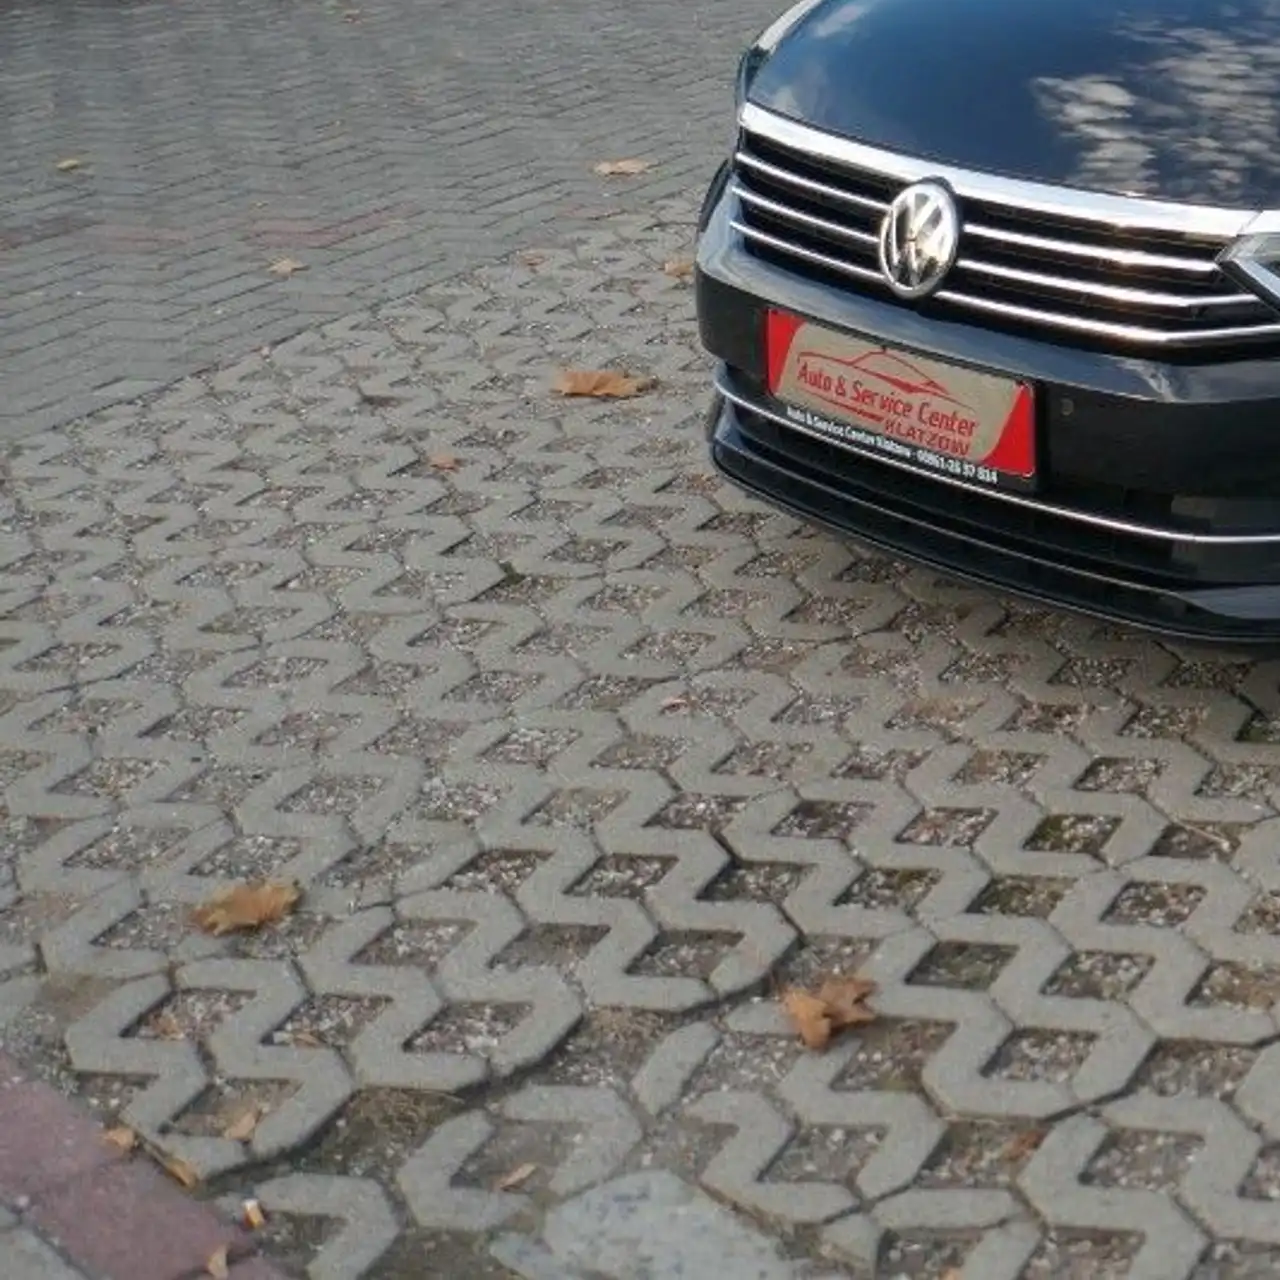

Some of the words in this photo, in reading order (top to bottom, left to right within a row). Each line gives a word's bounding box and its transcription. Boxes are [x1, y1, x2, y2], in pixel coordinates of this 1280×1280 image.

[797, 361, 832, 393] Auto
[834, 375, 847, 397] &
[851, 379, 913, 418] Service
[918, 402, 978, 438] Center
[884, 418, 971, 456] KLATZOW
